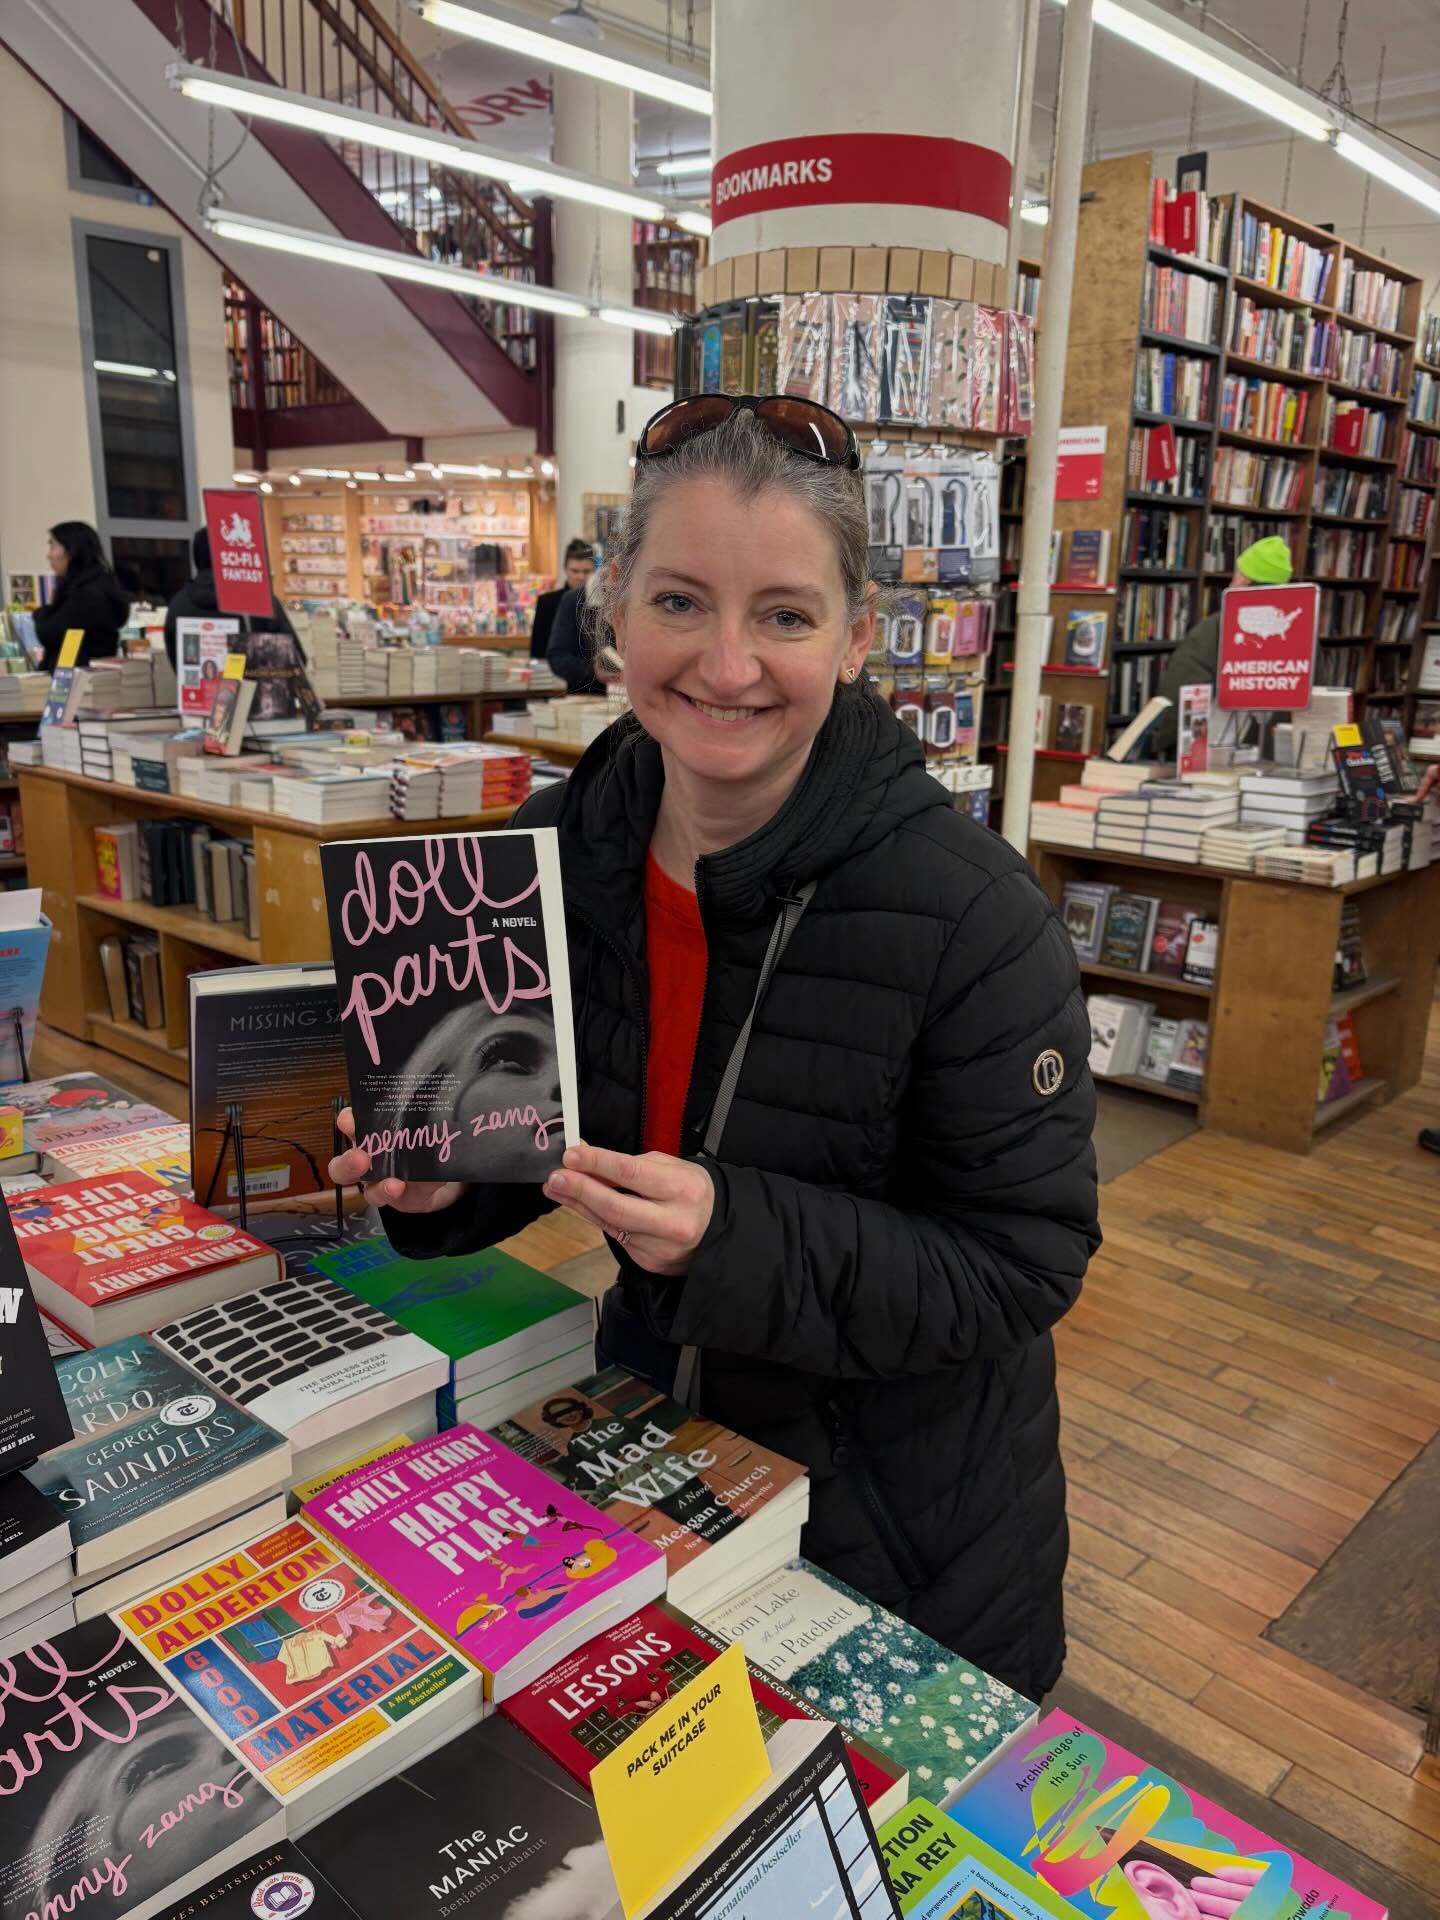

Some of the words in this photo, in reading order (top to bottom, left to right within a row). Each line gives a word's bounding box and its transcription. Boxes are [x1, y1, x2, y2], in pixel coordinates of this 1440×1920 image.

[453, 79, 551, 126] ORK
[715, 157, 833, 205] BOOKMARKS
[220, 551, 253, 567] SCI-FI
[222, 567, 263, 583] FANTASY
[1222, 659, 1309, 675] AMERICAN
[1229, 676, 1300, 691] HISTORY
[341, 837, 541, 946] doll
[492, 918, 500, 928] A
[502, 916, 537, 928] NOVEL
[341, 916, 552, 1066] parts
[230, 1009, 317, 1033] MISSING
[35, 1120, 122, 1144] CHECKER
[352, 1119, 462, 1171] penny
[470, 1104, 564, 1151] zang
[50, 1182, 136, 1211] LIFE
[70, 1215, 145, 1244] BIG
[74, 1224, 195, 1266] GREAT
[179, 1238, 261, 1268] EMILY
[87, 1261, 178, 1295] HENRY
[58, 1350, 143, 1395] COLN
[297, 1379, 320, 1393] THE
[317, 1363, 358, 1386] ENDLESS
[356, 1351, 389, 1371] WEEK
[310, 1377, 347, 1395] LAURA
[344, 1359, 389, 1383] VAZQUEZ
[72, 1390, 154, 1436] RDO
[73, 1386, 113, 1408] THE
[18, 1432, 36, 1446] BELL
[86, 1421, 168, 1466] GEORGE
[570, 1421, 625, 1450] The
[576, 1420, 677, 1486] Mad
[58, 1415, 236, 1512] SAUNDERS
[323, 1469, 411, 1529] EMILY
[405, 1432, 491, 1482] HENRY
[608, 1447, 717, 1509] Wife
[388, 1469, 511, 1549] HAPPY
[652, 1503, 717, 1551] Meagan
[713, 1463, 773, 1508] Church
[677, 1498, 687, 1510] A
[684, 1480, 713, 1503] Novel
[426, 1496, 551, 1576] PLACE
[684, 1536, 702, 1552] New
[700, 1521, 721, 1540] York
[719, 1508, 740, 1527] Times
[132, 1559, 248, 1629] DOLLY
[154, 1547, 330, 1653] ALDERTON
[714, 1619, 761, 1645] Tom
[757, 1585, 800, 1622] Lake
[689, 1624, 709, 1642] THE
[763, 1653, 787, 1672] nn
[780, 1605, 853, 1658] Patchett
[86, 1679, 97, 1689] A
[97, 1659, 138, 1683] NOVEL
[183, 1649, 260, 1728] GOOD
[386, 1700, 396, 1710] A
[395, 1689, 412, 1706] New
[411, 1677, 429, 1696] York
[428, 1661, 454, 1684] Times
[408, 1678, 449, 1706] Bestseller
[547, 1630, 673, 1721] LESSONS
[248, 1638, 437, 1764] MATERIAL
[626, 1741, 659, 1778] PACK
[658, 1725, 677, 1749] ME
[676, 1714, 691, 1733] IN
[690, 1682, 722, 1719] YOUR
[651, 1718, 707, 1777] SUITCASE
[1014, 1734, 1076, 1793] Archipelago
[1070, 1725, 1083, 1743] of
[1048, 1769, 1070, 1789] the
[1066, 1751, 1089, 1774] Sun
[139, 1767, 250, 1850] zang
[428, 1825, 529, 1901] MANIAC
[437, 1827, 488, 1862] The
[498, 1836, 548, 1877] Labatut
[915, 1832, 958, 1872] REY
[199, 1853, 286, 1907] BESTSELLER
[252, 1887, 265, 1908] Read
[280, 1873, 304, 1885] Jenna
[674, 1876, 714, 1915] undeniable
[713, 1828, 757, 1885] page-turner.”
[712, 1866, 763, 1920] ternational
[761, 1828, 803, 1873] bestseller
[926, 1894, 949, 1917] gorgeous
[947, 1881, 962, 1897] prose
[1288, 1889, 1320, 1920] awada
